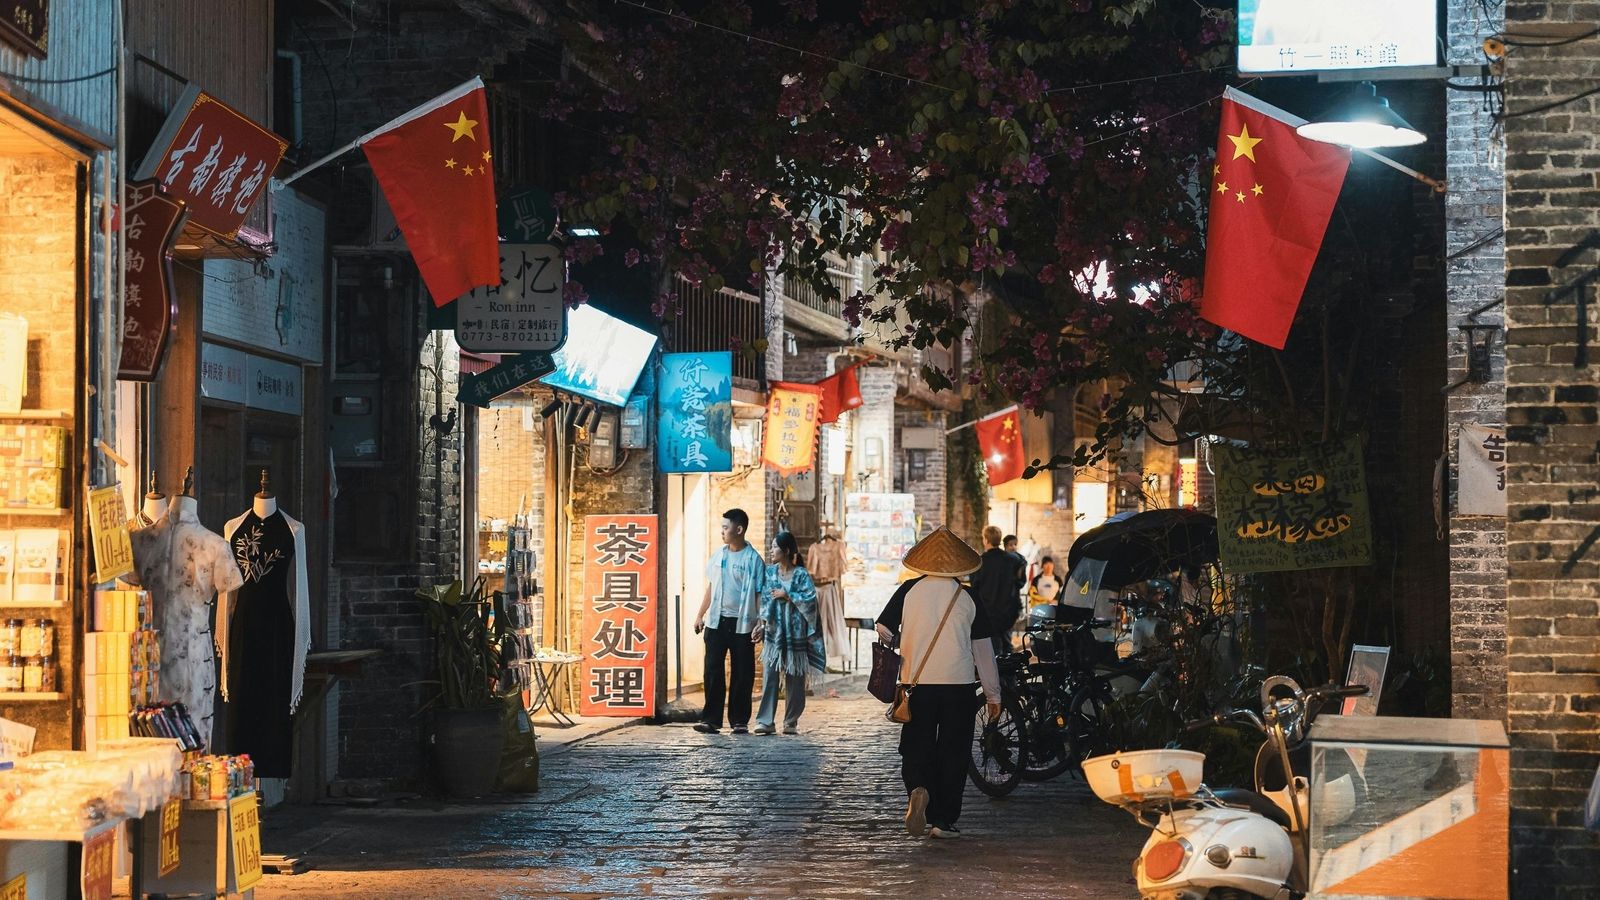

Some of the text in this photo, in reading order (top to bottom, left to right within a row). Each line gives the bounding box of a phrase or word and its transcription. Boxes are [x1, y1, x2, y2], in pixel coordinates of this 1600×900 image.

[489, 301, 536, 312] Ron inn
[461, 332, 559, 342] 0773-8702111
[474, 355, 548, 397] 我们在这
[1233, 486, 1353, 543] 柠檬茶
[590, 524, 650, 708] 茶具处理
